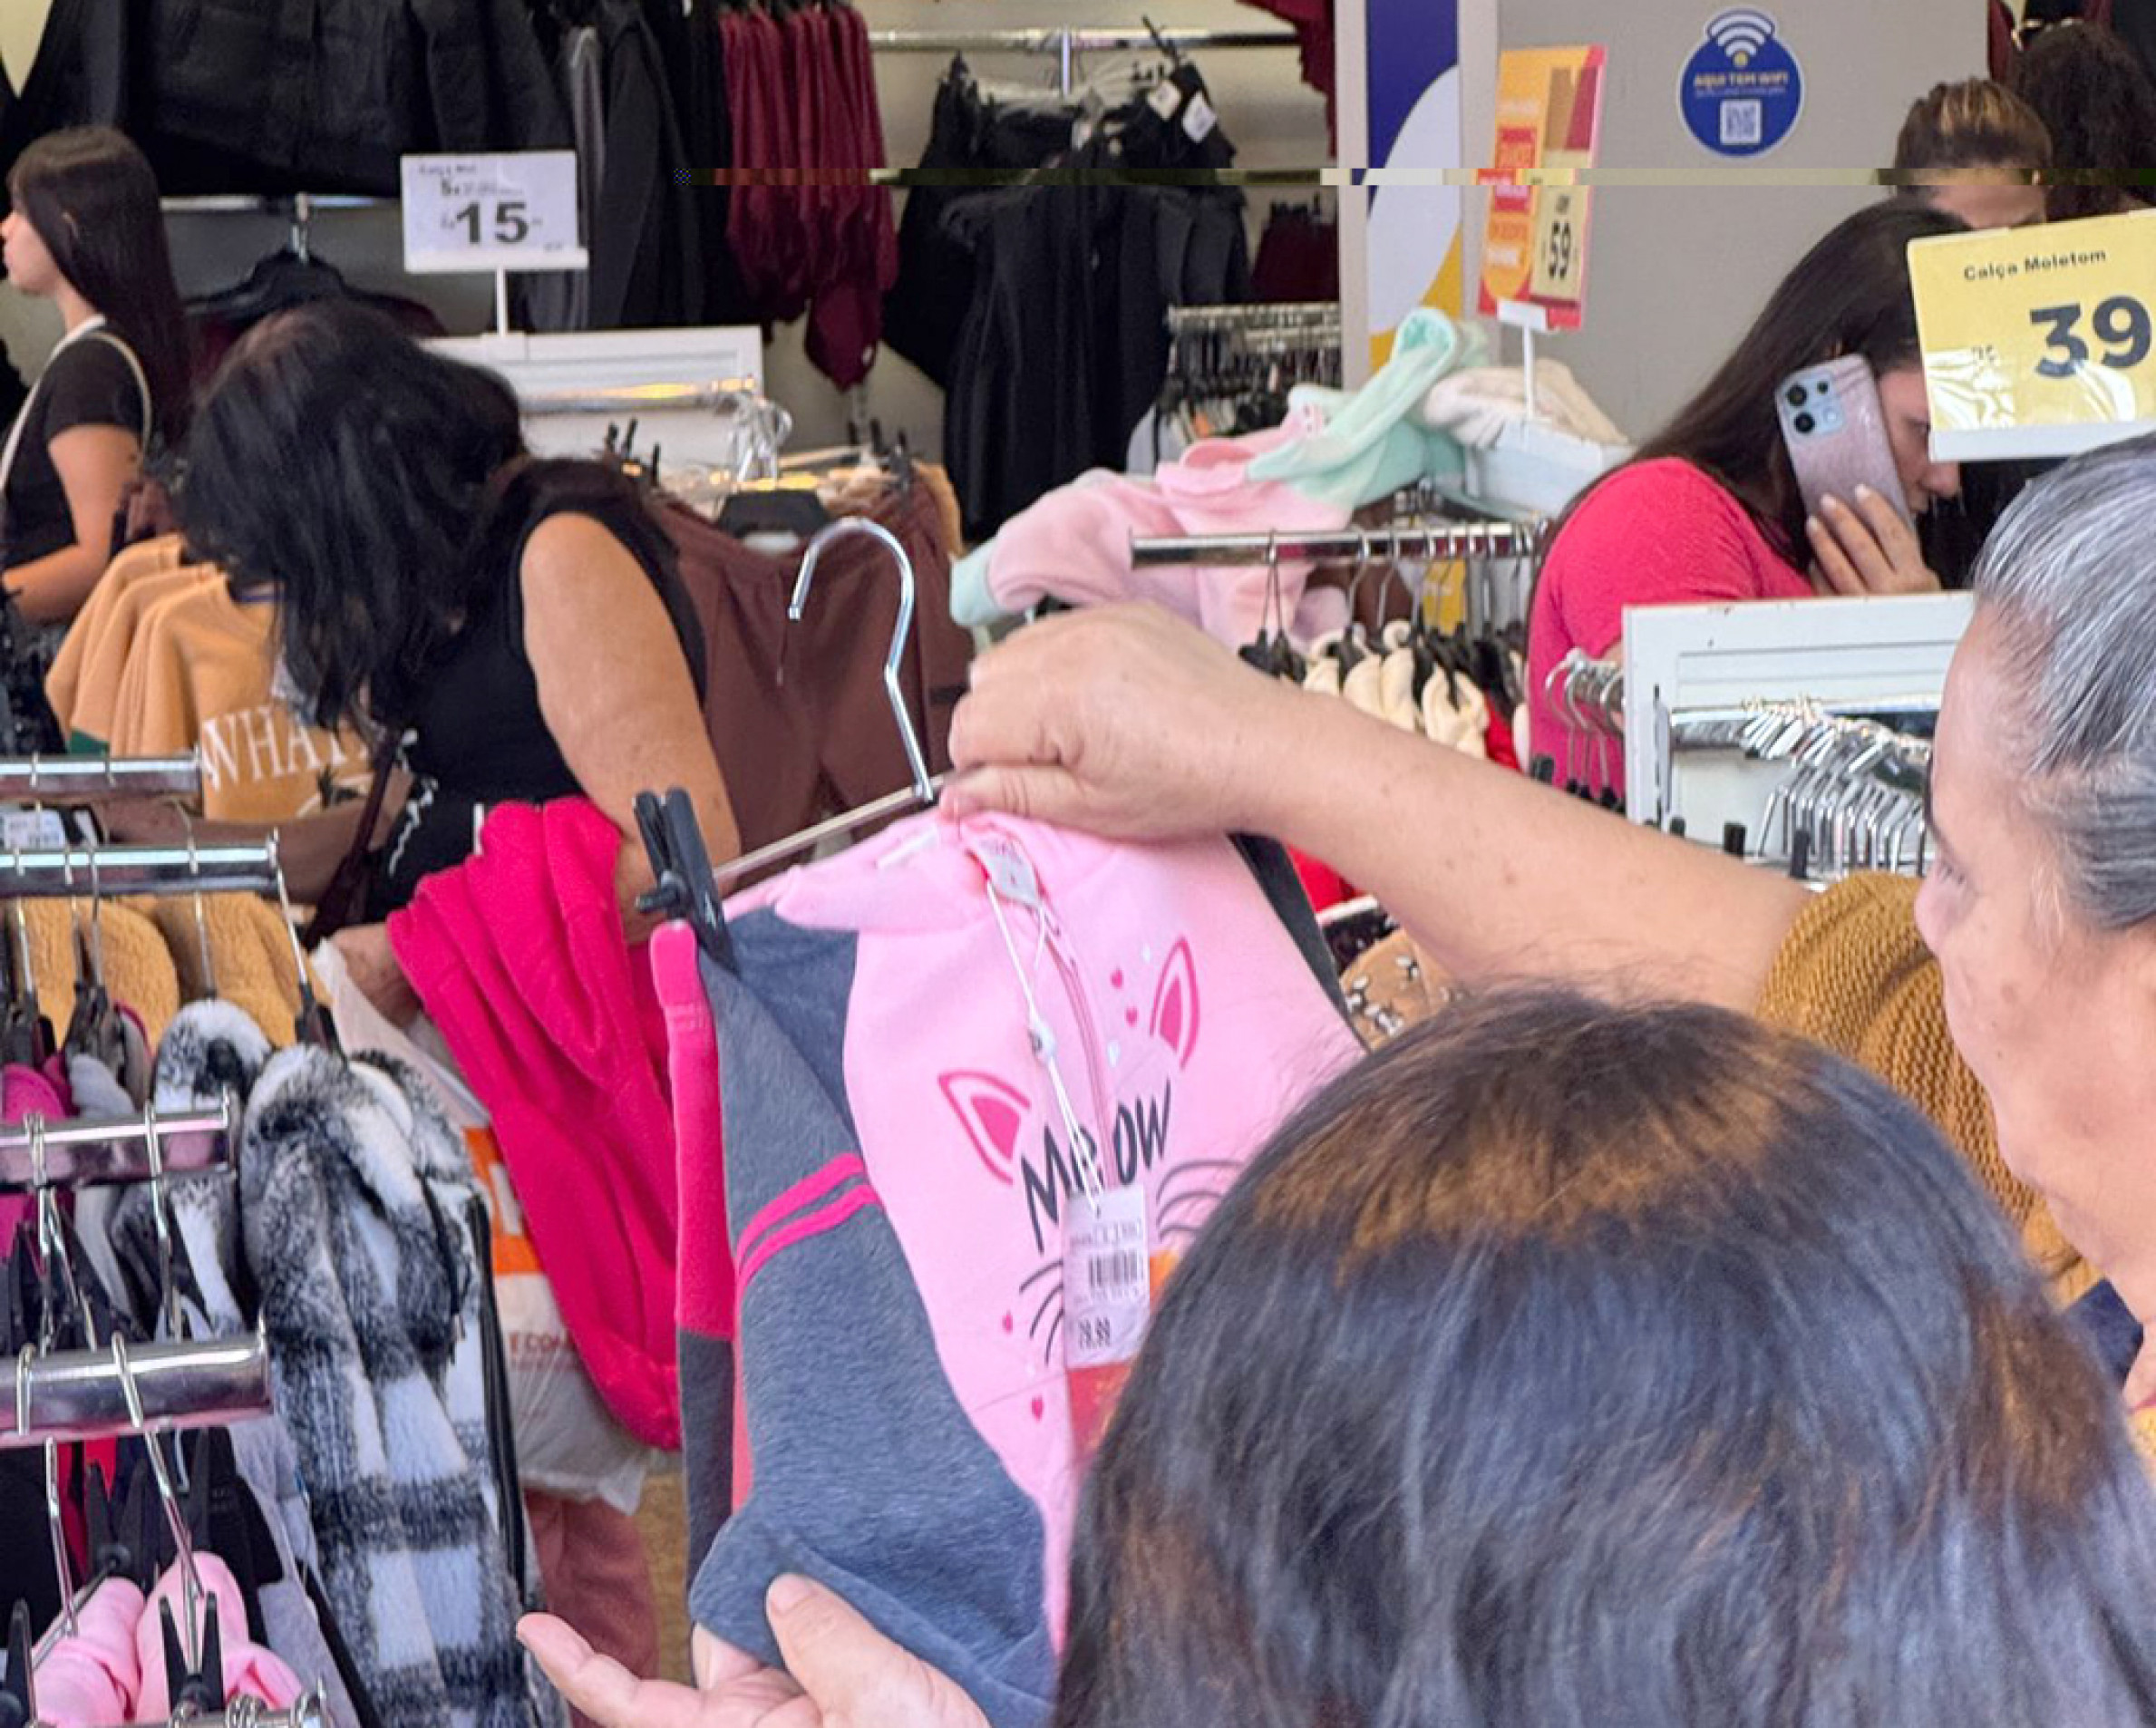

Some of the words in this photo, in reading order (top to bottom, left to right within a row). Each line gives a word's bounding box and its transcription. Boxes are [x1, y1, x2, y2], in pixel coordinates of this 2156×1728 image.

[456, 200, 529, 245] 15
[1548, 220, 1571, 279] 59
[1964, 261, 2018, 281] Calça
[2025, 249, 2106, 272] Moletom
[2028, 295, 2152, 378] 39
